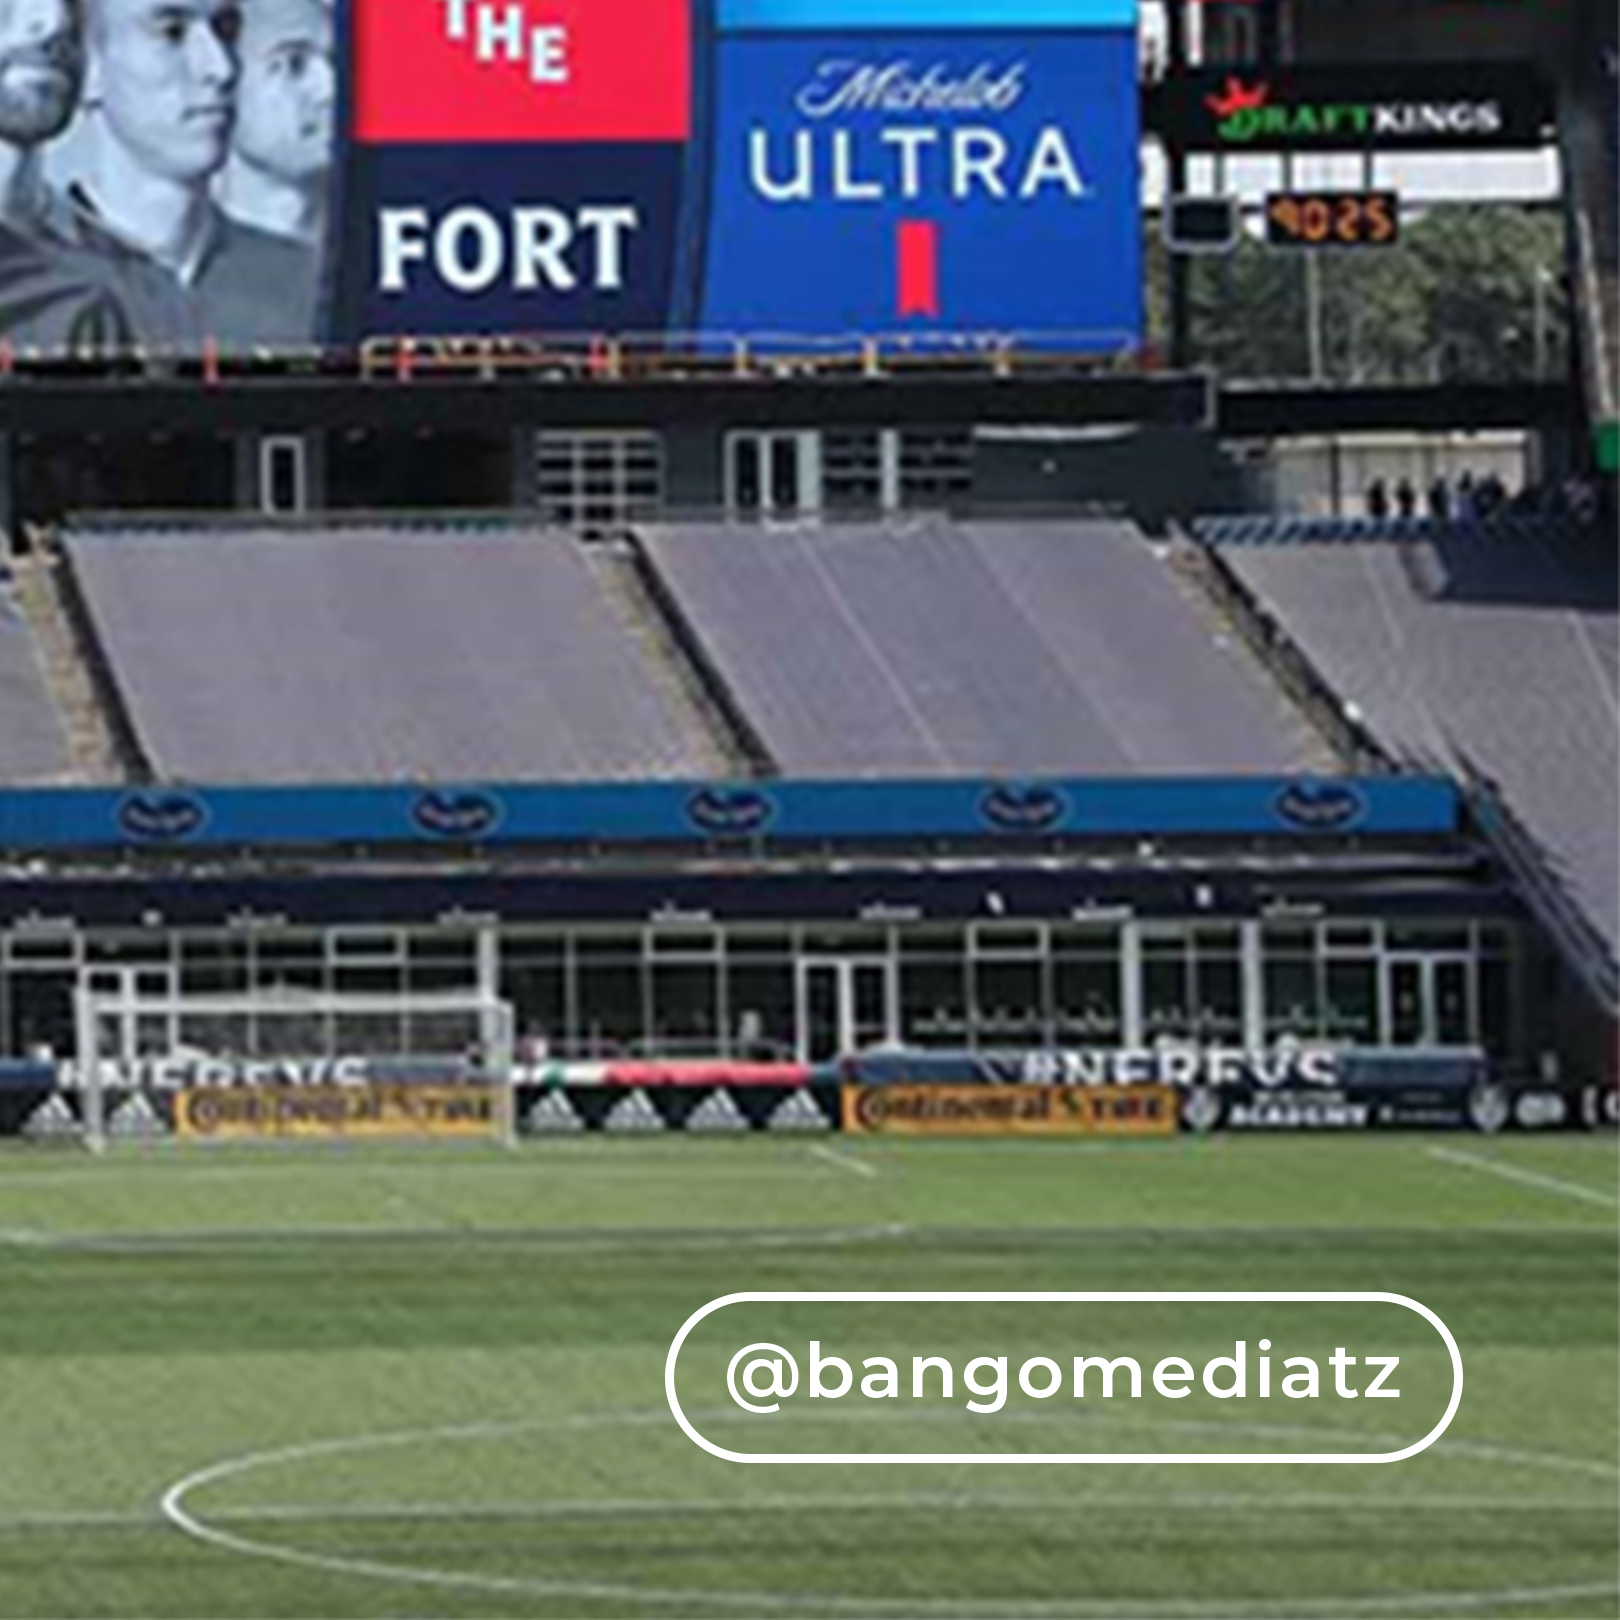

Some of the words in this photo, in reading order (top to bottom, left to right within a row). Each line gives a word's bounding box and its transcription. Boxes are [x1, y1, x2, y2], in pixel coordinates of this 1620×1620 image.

[796, 57, 1025, 119] Michelob
[748, 128, 1084, 201] ULTRA
[378, 206, 638, 291] FORT
